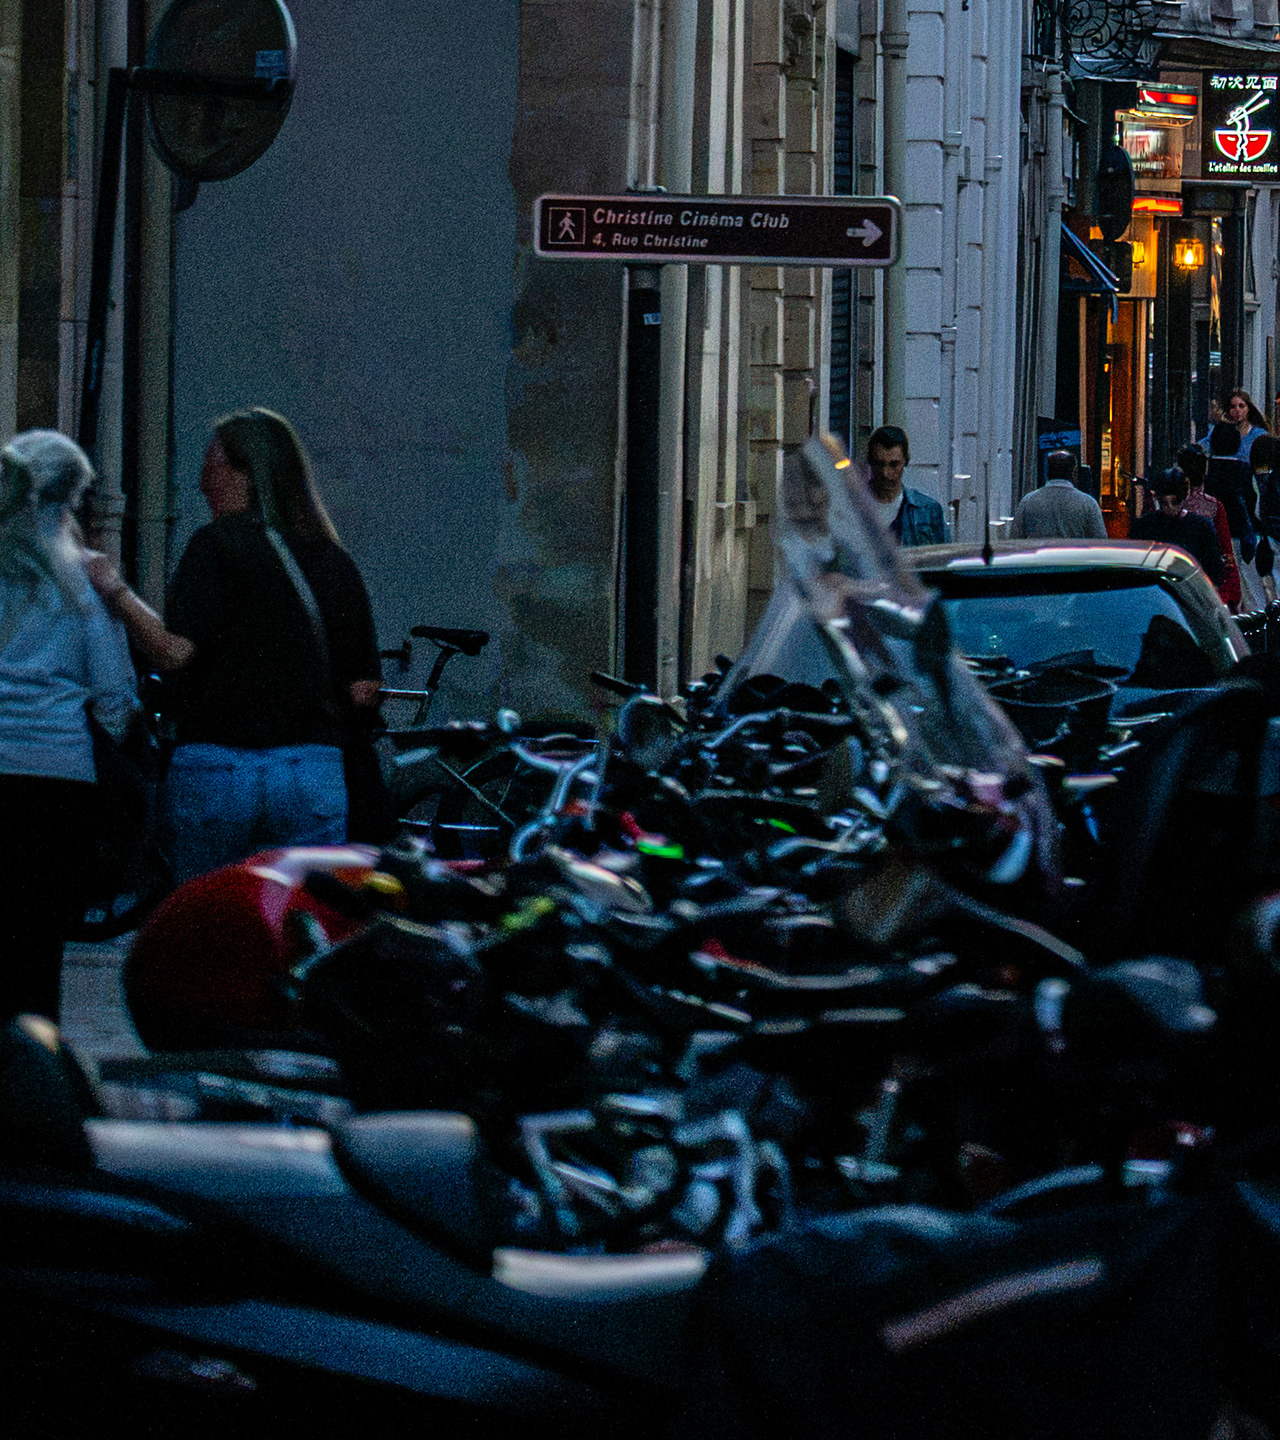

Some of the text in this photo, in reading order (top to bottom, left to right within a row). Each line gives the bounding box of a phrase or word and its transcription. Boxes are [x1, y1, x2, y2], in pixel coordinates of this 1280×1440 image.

[592, 208, 790, 229] Christine Cinéma Club
[611, 233, 639, 247] Rue
[643, 233, 709, 248] Christine
